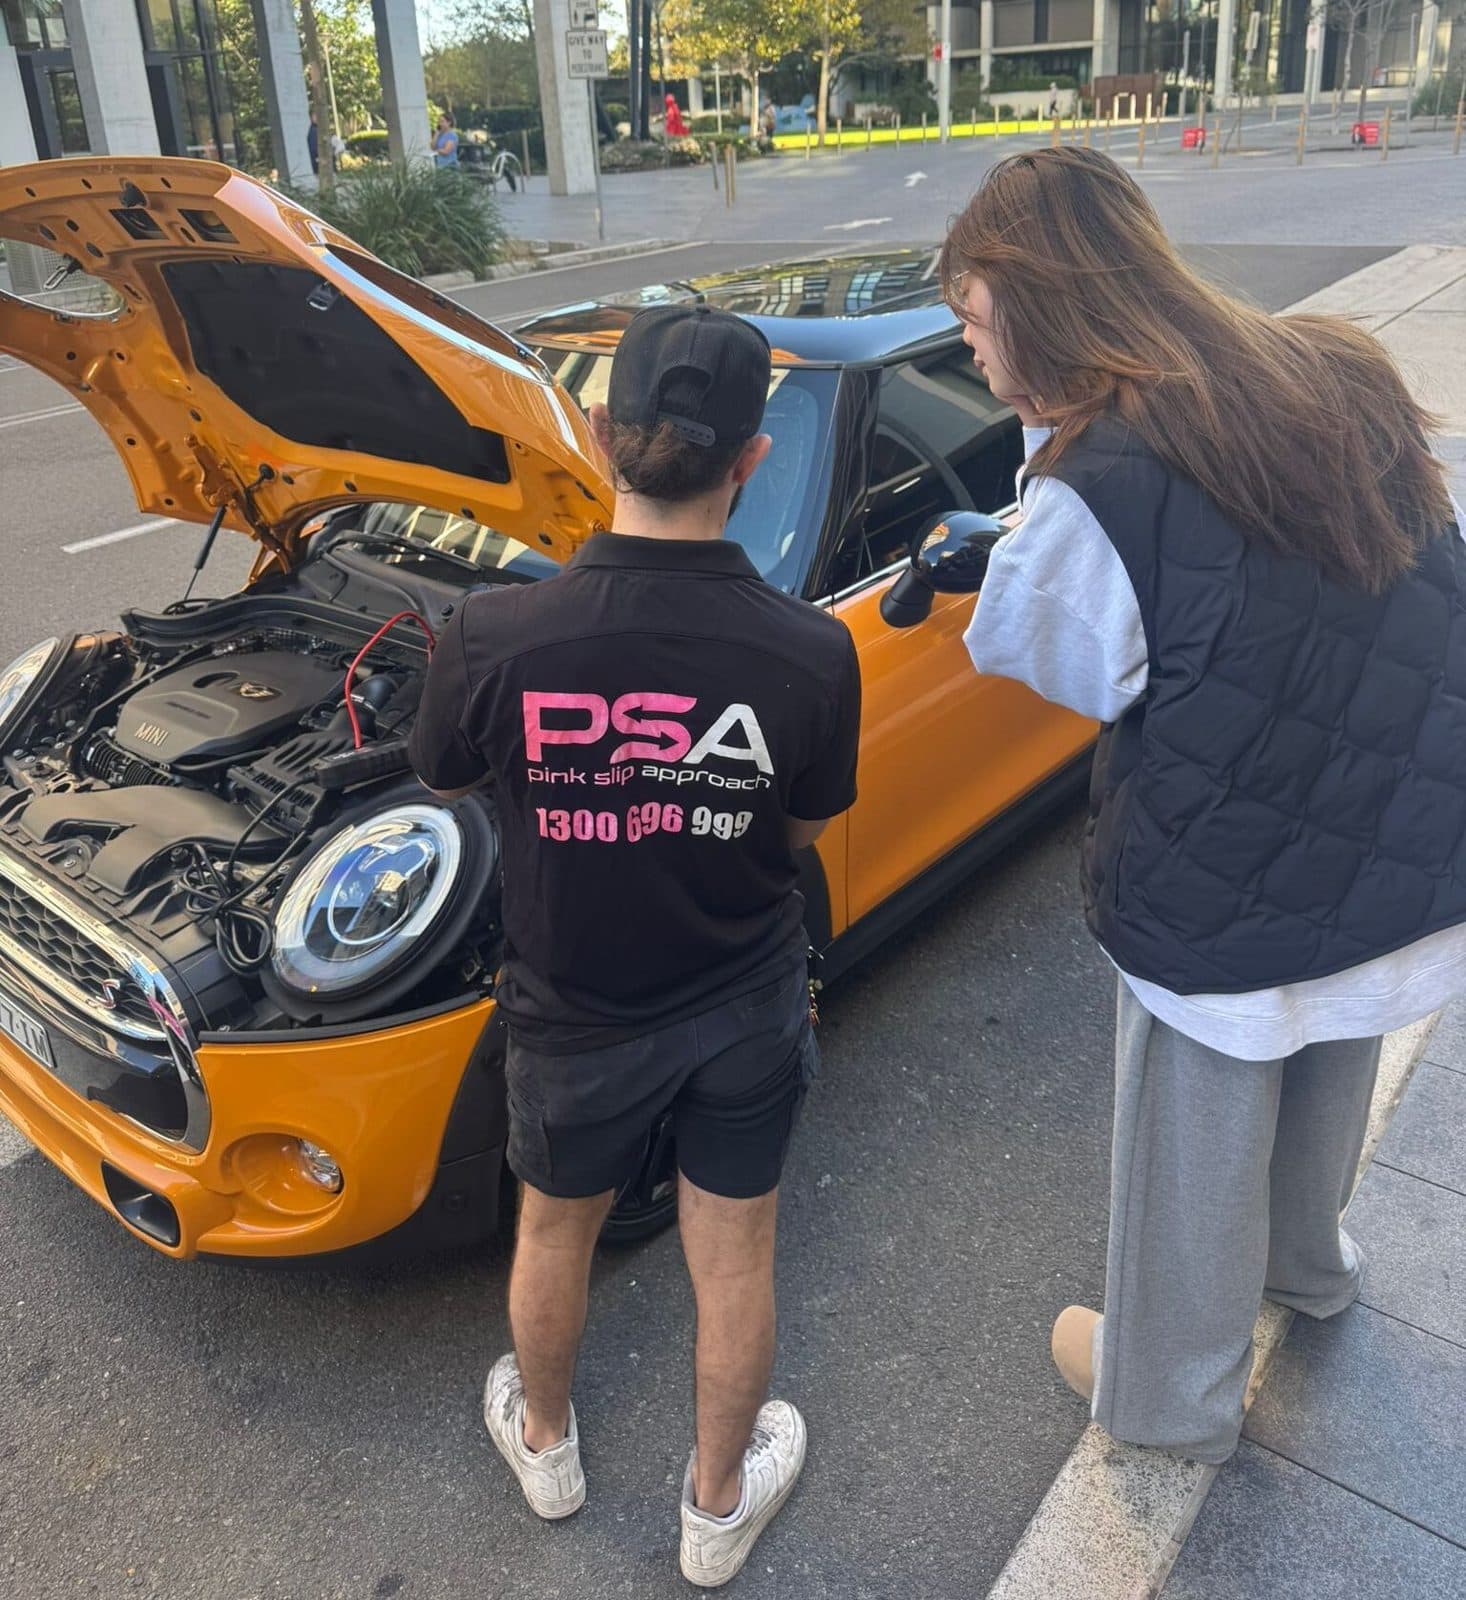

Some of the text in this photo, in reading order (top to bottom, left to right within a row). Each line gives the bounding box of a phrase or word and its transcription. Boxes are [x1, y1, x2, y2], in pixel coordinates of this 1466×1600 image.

[568, 36, 604, 46] GIVE WAY
[583, 49, 592, 60] TO
[134, 722, 168, 746] MINI
[523, 691, 774, 775] PSA
[527, 765, 770, 790] pink slip approach
[536, 802, 753, 843] 1300 696 999
